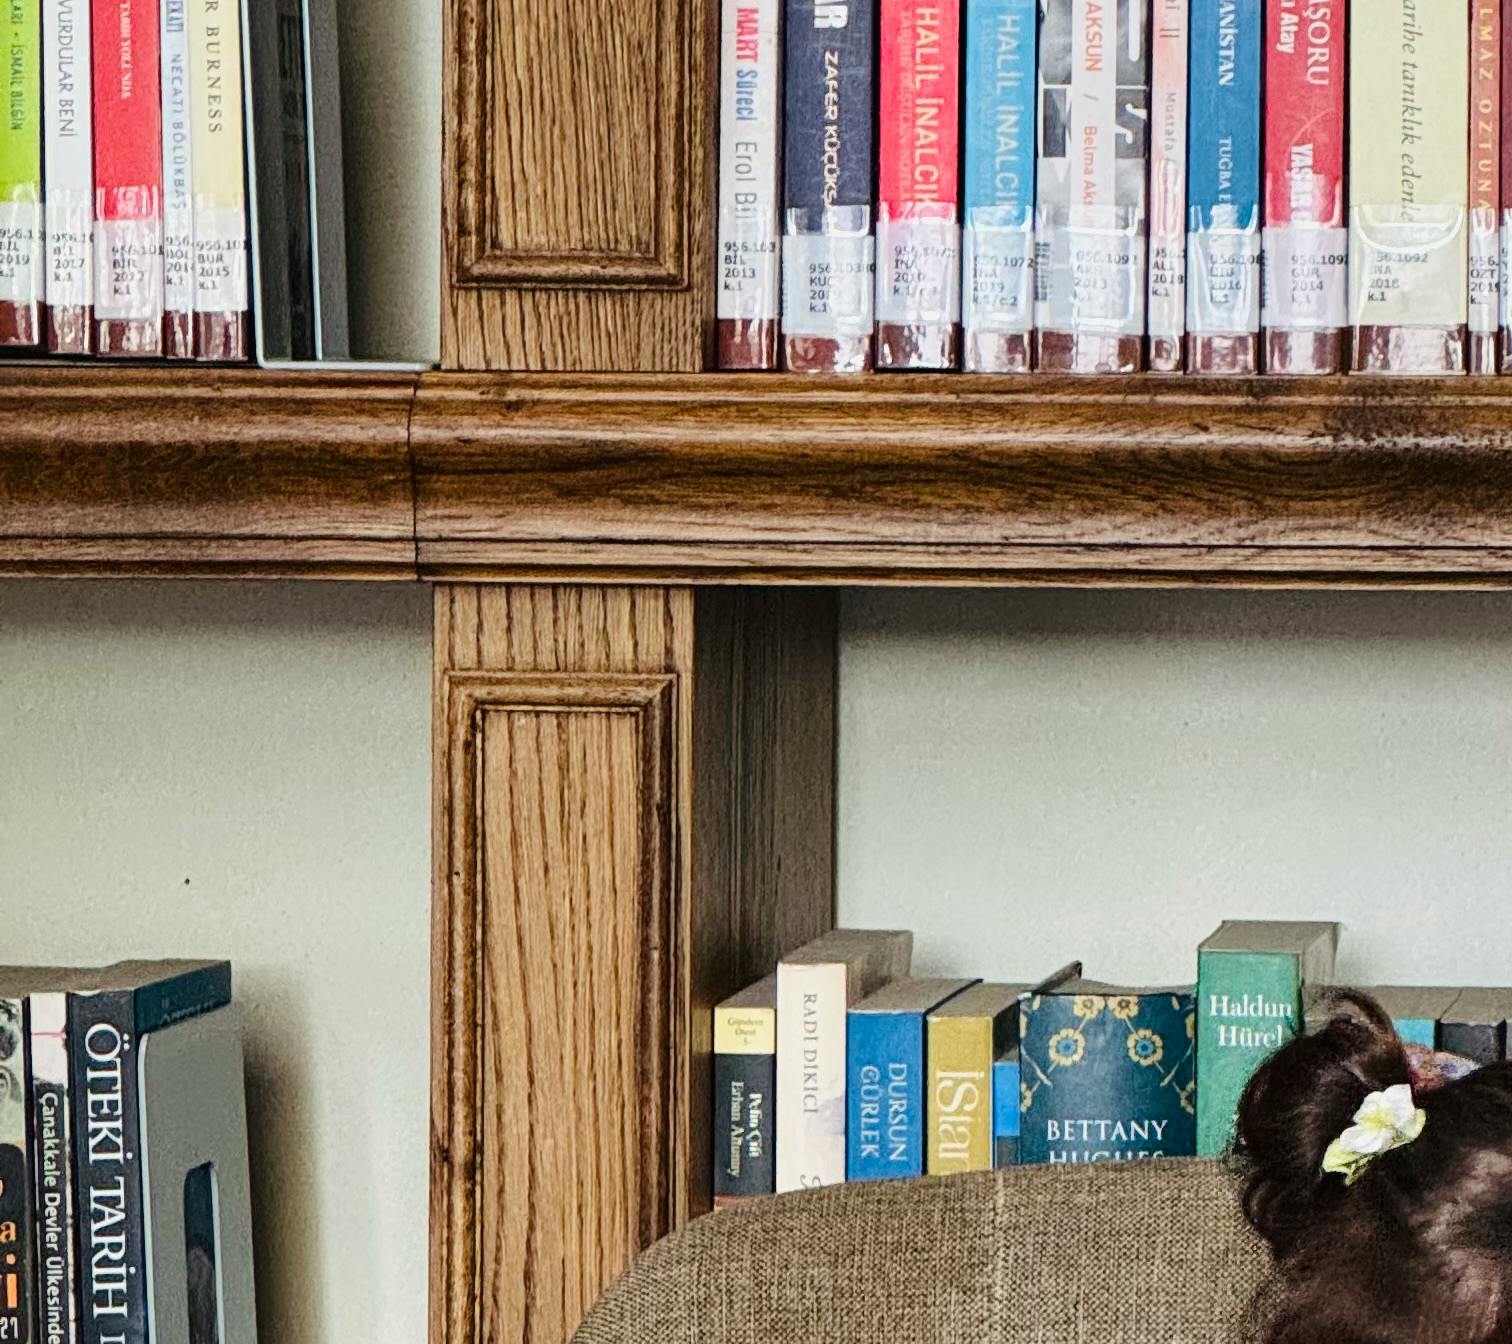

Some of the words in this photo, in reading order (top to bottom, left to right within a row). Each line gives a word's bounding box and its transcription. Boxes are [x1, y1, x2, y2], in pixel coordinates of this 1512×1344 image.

[738, 8, 760, 62] MART
[915, 8, 943, 91] HALİL
[1085, 2, 1104, 72] AKSUN
[205, 26, 223, 134] BURNESS
[738, 69, 760, 122] Süreci
[1208, 995, 1292, 1019] Haldun
[84, 1023, 132, 1164] ÖTEKİ
[858, 1065, 881, 1158] GÜRLEK
[887, 1063, 907, 1163] DURSUN
[1046, 1120, 1167, 1142] BETTANY
[38, 1092, 60, 1187] Çanakkale
[44, 1191, 62, 1250] Devler
[89, 1176, 136, 1318] TARİH
